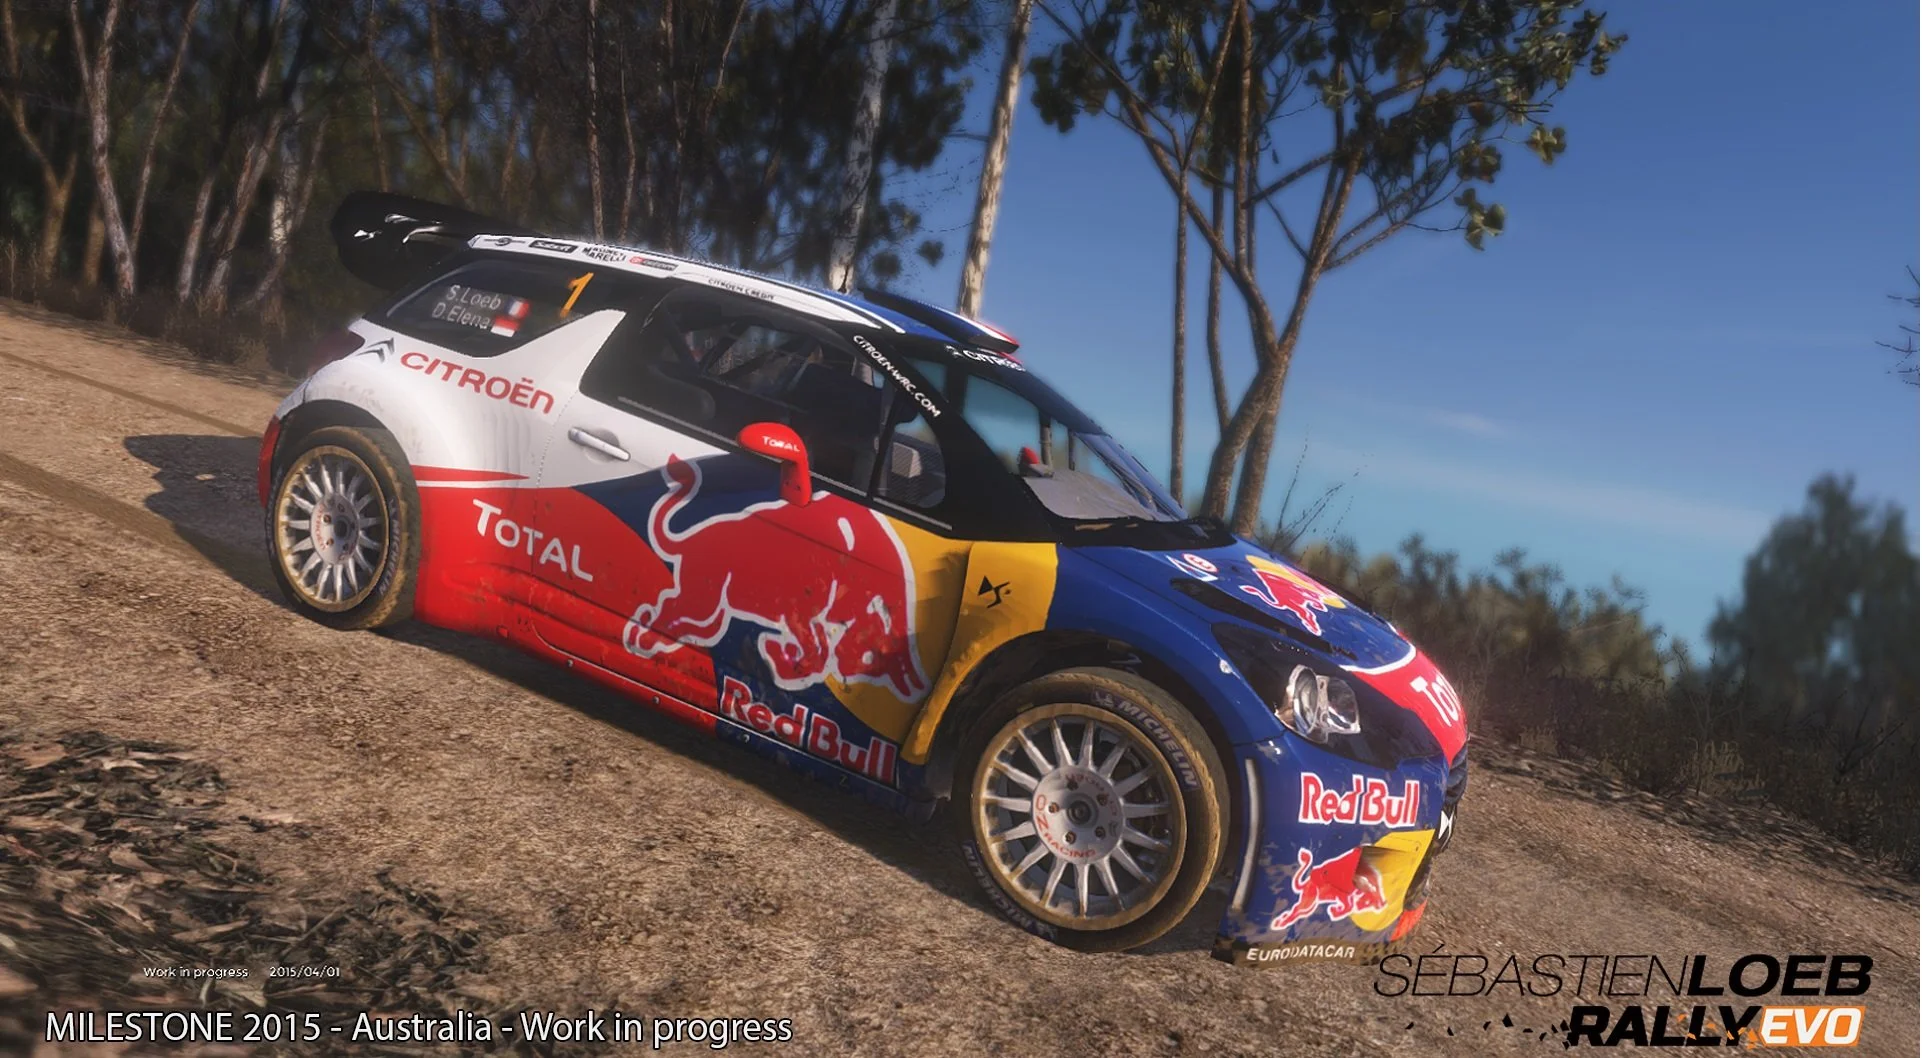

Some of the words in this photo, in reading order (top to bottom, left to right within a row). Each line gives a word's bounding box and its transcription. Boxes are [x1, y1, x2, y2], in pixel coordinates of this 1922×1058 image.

[431, 302, 491, 329] D.Elena
[446, 284, 502, 310] S.Loeb
[560, 272, 594, 318] 1
[473, 498, 593, 582] TOTAL
[720, 675, 809, 750] Red
[807, 712, 899, 787] Bull
[1118, 700, 1197, 787] MICHELIN
[1299, 772, 1363, 825] Red
[1360, 778, 1420, 828] Bull
[1247, 944, 1355, 963] EURODATACAR
